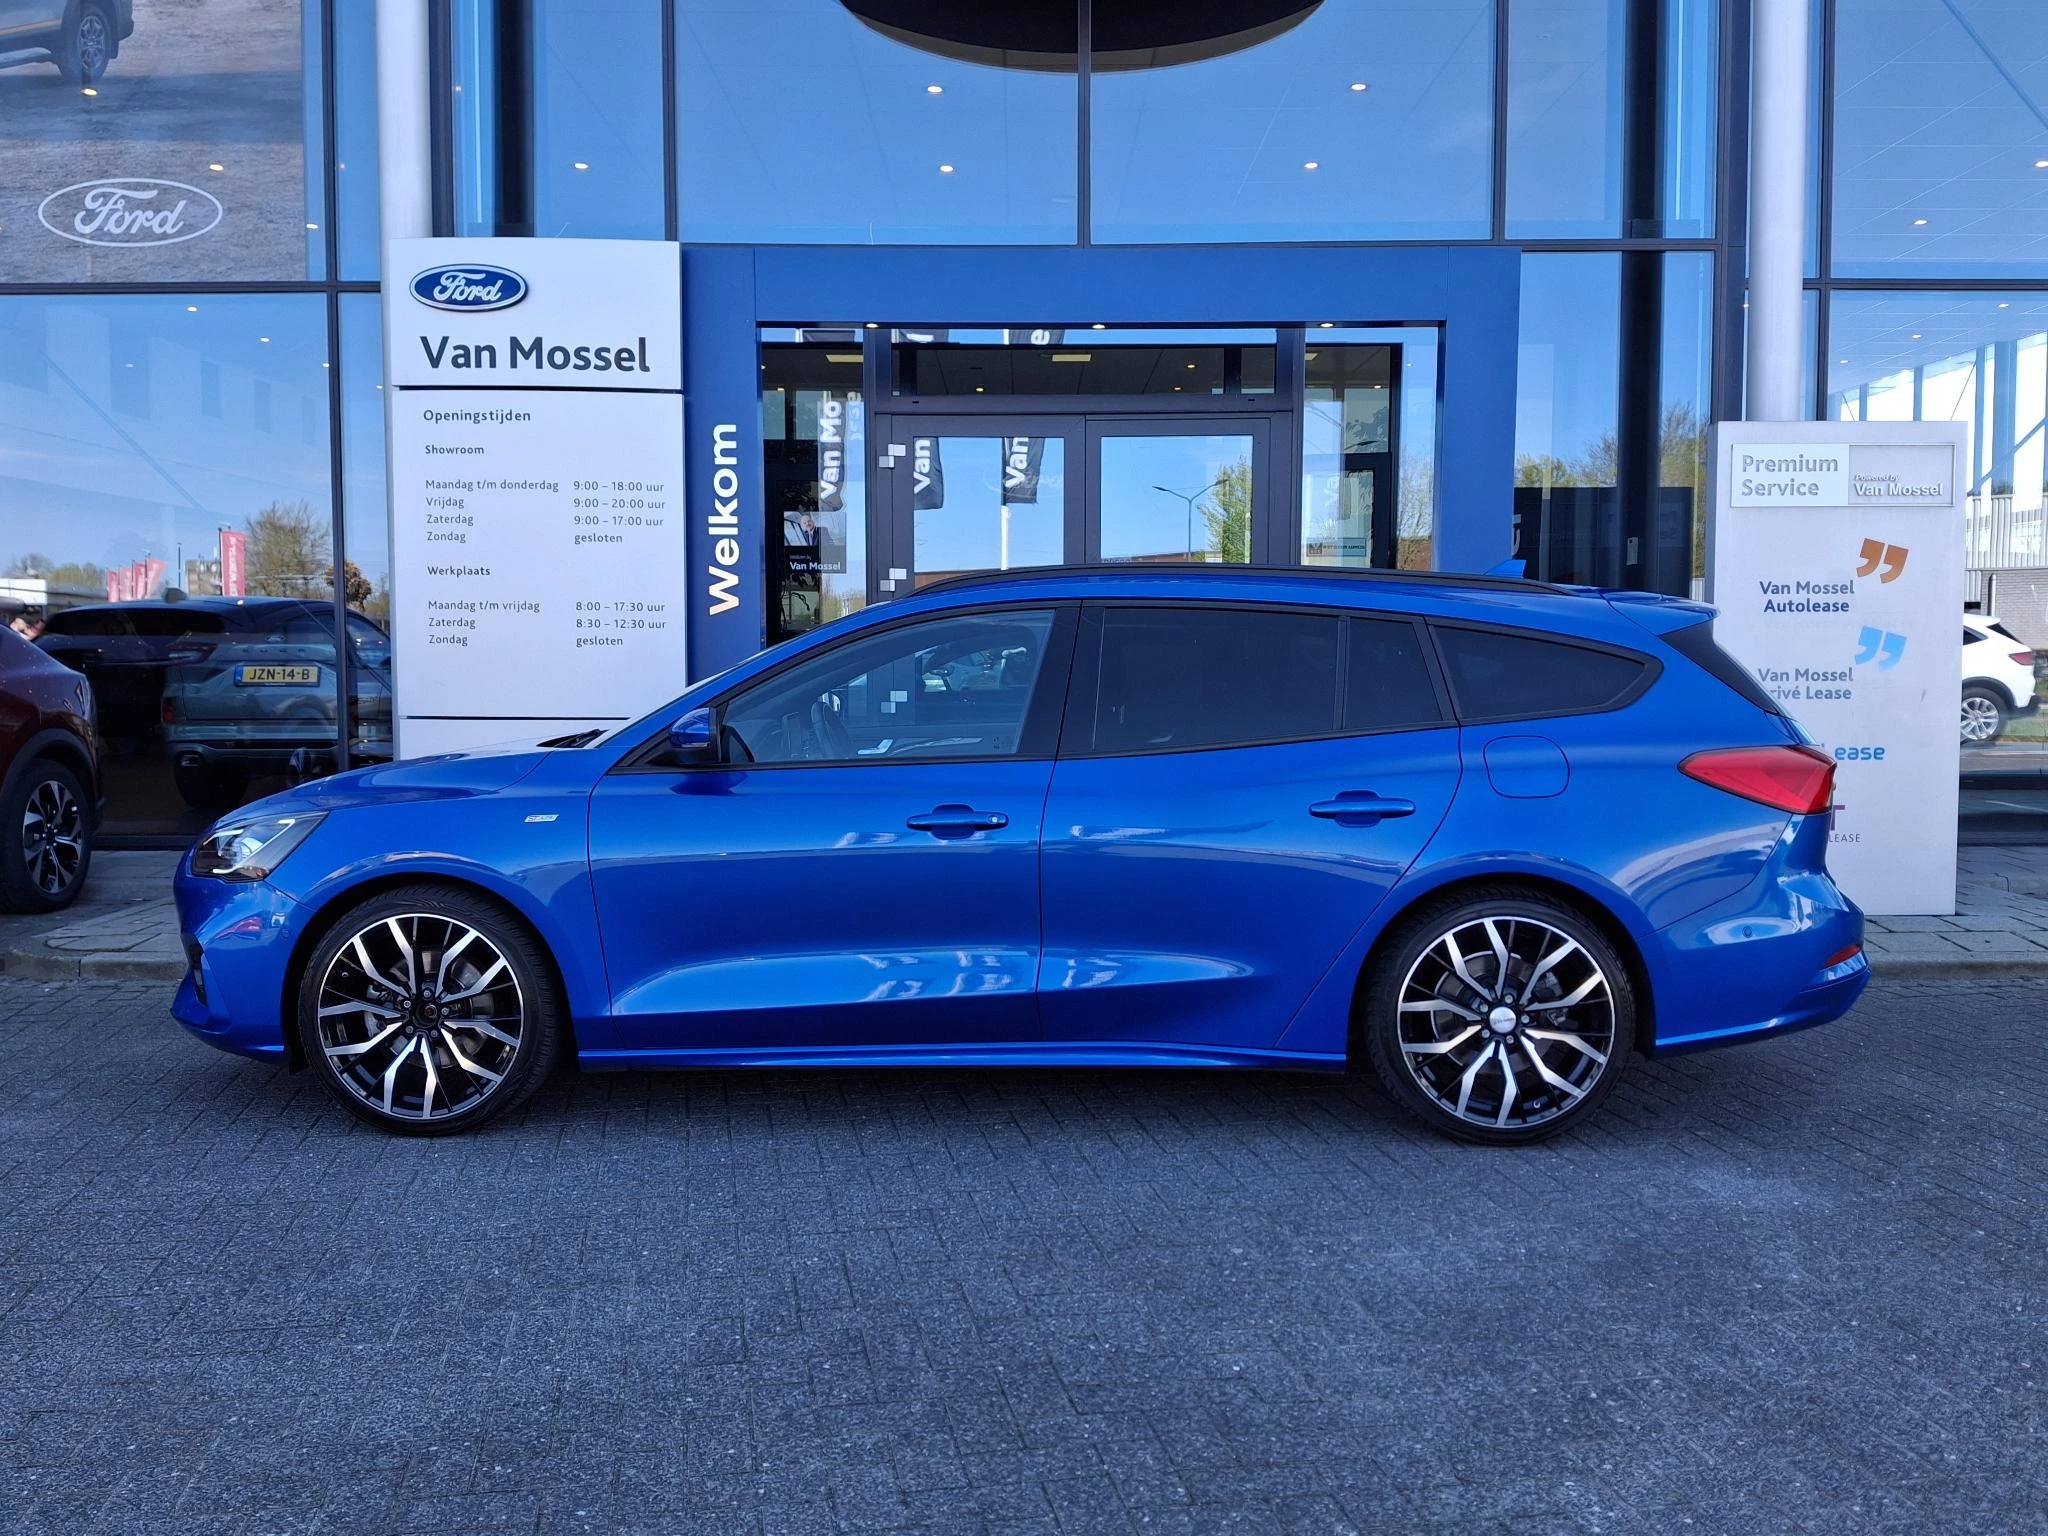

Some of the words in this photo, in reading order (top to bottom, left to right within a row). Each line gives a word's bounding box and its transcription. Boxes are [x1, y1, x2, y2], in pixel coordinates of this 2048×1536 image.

[74, 187, 187, 234] Ford
[433, 271, 504, 301] Ford
[419, 335, 497, 369] Van
[509, 335, 651, 373] Mossel
[423, 408, 531, 425] Openingstijden
[424, 444, 485, 455] Showroom
[913, 439, 931, 494] Van
[1005, 437, 1029, 488] Van
[1742, 453, 1839, 473] Premium
[425, 479, 474, 493] Maandag
[476, 479, 497, 490] t/m
[499, 479, 559, 493] donderdag
[573, 480, 599, 491] 9:00
[611, 480, 643, 492] 18:00
[646, 484, 665, 493] uur
[1741, 477, 1820, 497] Service
[1854, 483, 1884, 497] Van
[1887, 482, 1944, 497] Mossel
[425, 496, 465, 510] Vrijdag
[573, 497, 599, 509] 9:00
[611, 498, 644, 509] 20:00
[647, 501, 666, 510] uur
[426, 513, 474, 527] Zaterdag
[573, 515, 600, 526] 9:00
[611, 515, 643, 526] 17:00
[645, 518, 664, 527] uur
[708, 424, 740, 616] Welkom
[426, 530, 467, 544] Zondag
[574, 532, 623, 546] gesloten
[426, 565, 491, 579] Werkplaats
[789, 561, 807, 570] Van
[809, 561, 841, 570] Mossel
[1759, 580, 1791, 595] Van
[1795, 579, 1856, 595] Mossel
[428, 599, 477, 613] Maandag
[478, 599, 500, 611] t/m
[502, 599, 541, 614] vrijdag
[575, 601, 601, 612] 8:00
[613, 601, 644, 612] 17:30
[646, 604, 665, 613] uur
[1763, 597, 1850, 613] Autolease
[428, 616, 476, 630] Zaterdag
[576, 618, 601, 629] 8:30
[613, 618, 645, 629] 12:30
[648, 621, 666, 629] uur
[428, 633, 468, 648] Zondag
[575, 635, 624, 649] gesloten
[249, 668, 310, 680] JZN-14-B
[1757, 667, 1790, 682] Van
[1794, 666, 1854, 682] Mossel
[1805, 685, 1852, 700] Lease
